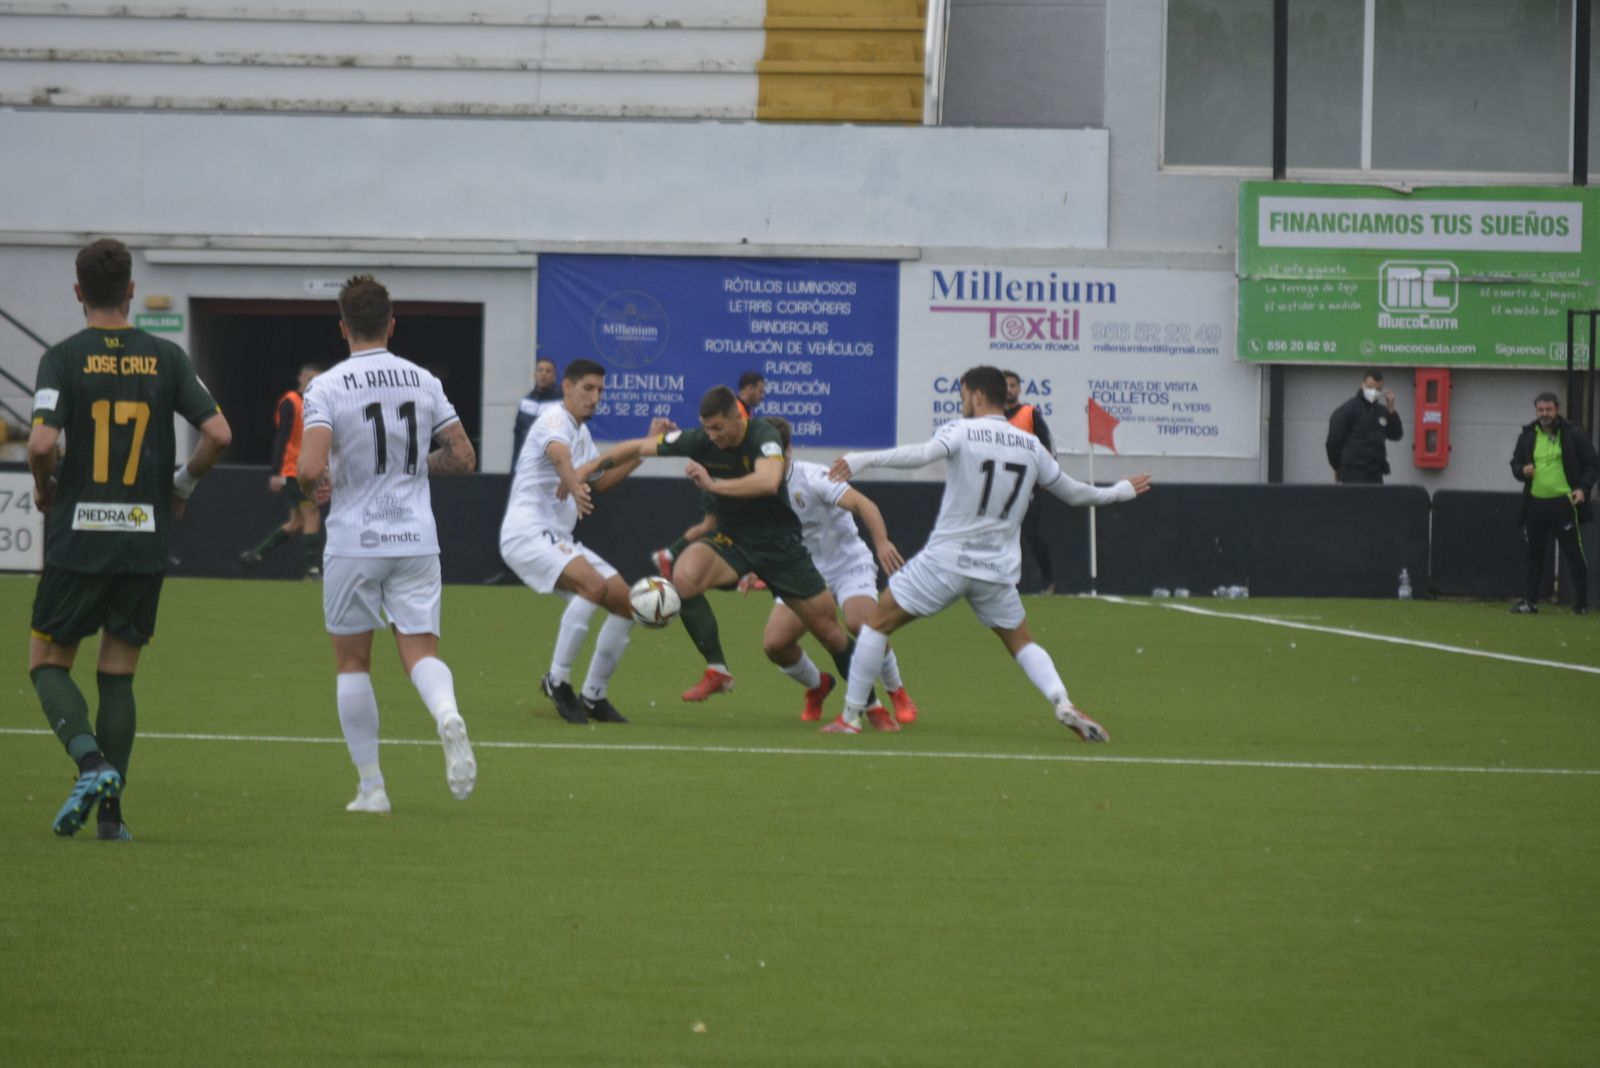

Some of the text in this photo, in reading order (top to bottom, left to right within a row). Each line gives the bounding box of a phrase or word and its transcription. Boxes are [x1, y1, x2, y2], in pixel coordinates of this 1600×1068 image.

[1269, 210, 1570, 237] FINANCIAMOS TUS SUEÑOS
[724, 277, 857, 296] RÓTULOS LUMINOSOS
[930, 269, 1118, 304] Millenium
[1387, 267, 1451, 308] MC
[729, 299, 851, 316] LETRAS CORPÓREAS
[603, 323, 658, 336] Millenium
[751, 320, 829, 335] BANDEROLAS
[930, 306, 1080, 341] Textil
[705, 338, 874, 357] ROTULACIÓN DE VEHÍCULOS
[1290, 342, 1304, 351] 20
[83, 355, 158, 376] JOSE CRUZ
[765, 361, 813, 375] PLACAS
[365, 369, 421, 389] RAILLO
[603, 374, 684, 391] LLENIUM
[1088, 380, 1199, 393] TARJETAS DE VISITA
[1092, 391, 1170, 405] FOLLETOS
[595, 403, 671, 416] 56 52 22 49
[1172, 403, 1211, 413] FLYERS
[92, 400, 150, 485] 17
[364, 401, 417, 475] 11
[967, 429, 992, 443] LUIS
[976, 459, 1027, 519] 17
[78, 508, 126, 523] PIEDRA
